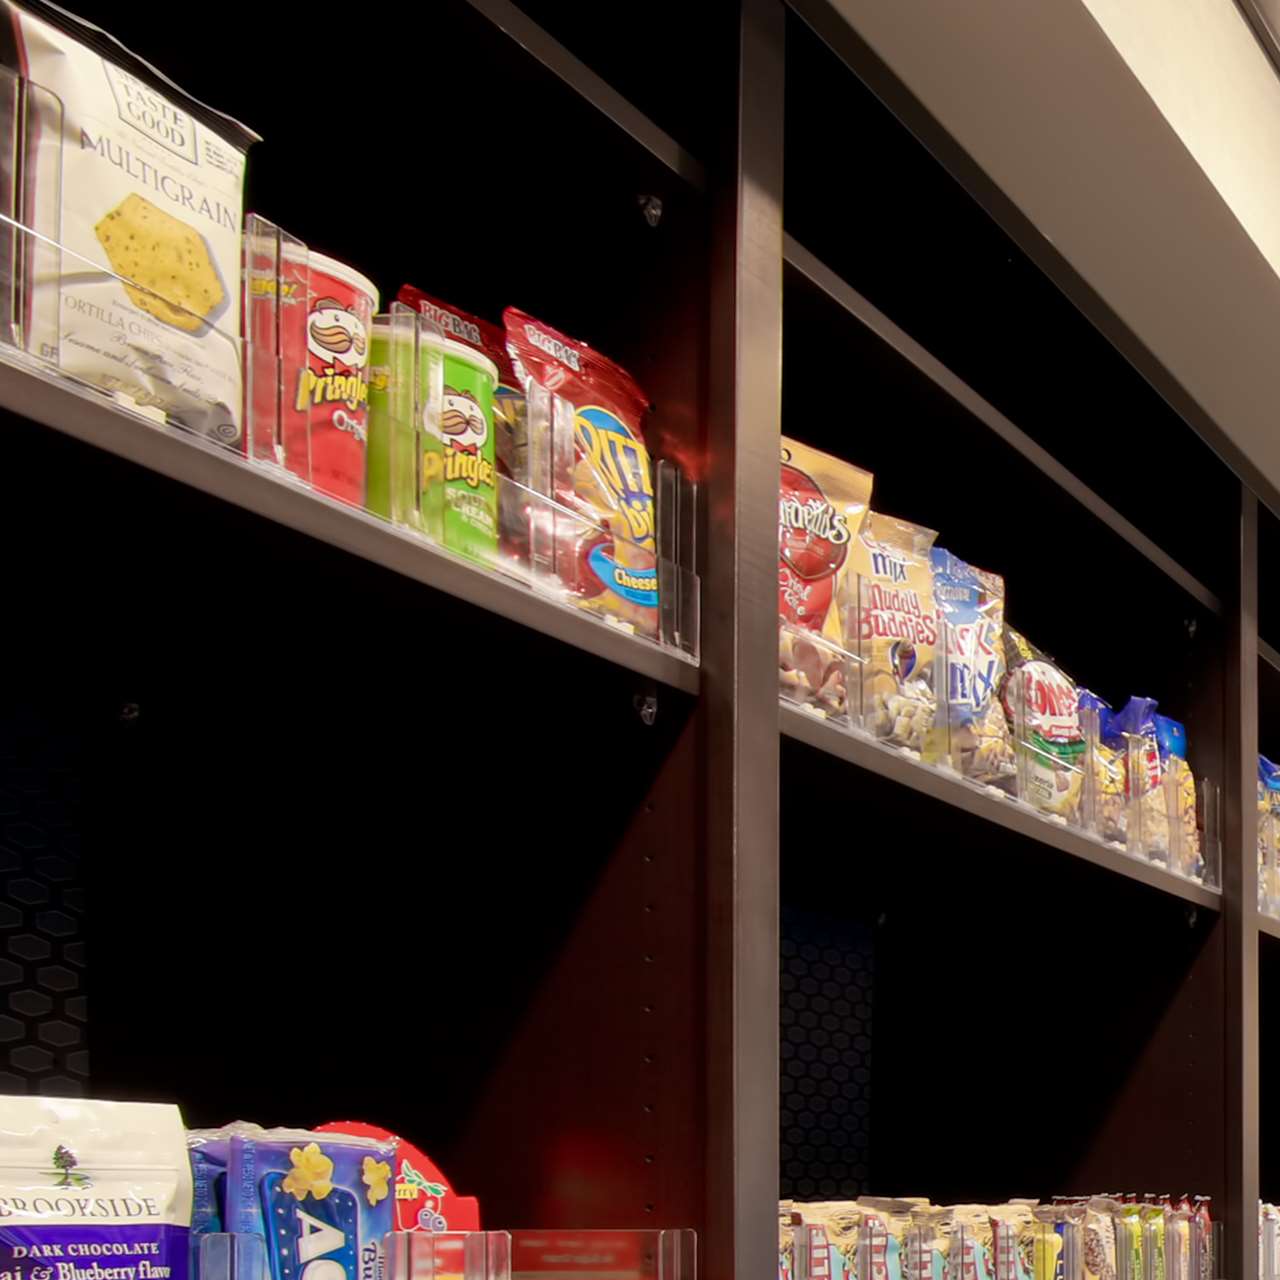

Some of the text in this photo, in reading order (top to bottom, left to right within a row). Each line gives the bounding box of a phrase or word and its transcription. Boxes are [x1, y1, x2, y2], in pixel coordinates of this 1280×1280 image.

[122, 82, 184, 128] TASTE
[127, 101, 185, 148] GOOD
[80, 128, 237, 232] MULTIGRAIN
[63, 294, 125, 331] ORTILLA
[420, 300, 481, 346] BIG BAG
[551, 341, 580, 371] BAG
[613, 567, 658, 590] Cheese
[12, 1243, 160, 1259] DARK CHOCOLATE
